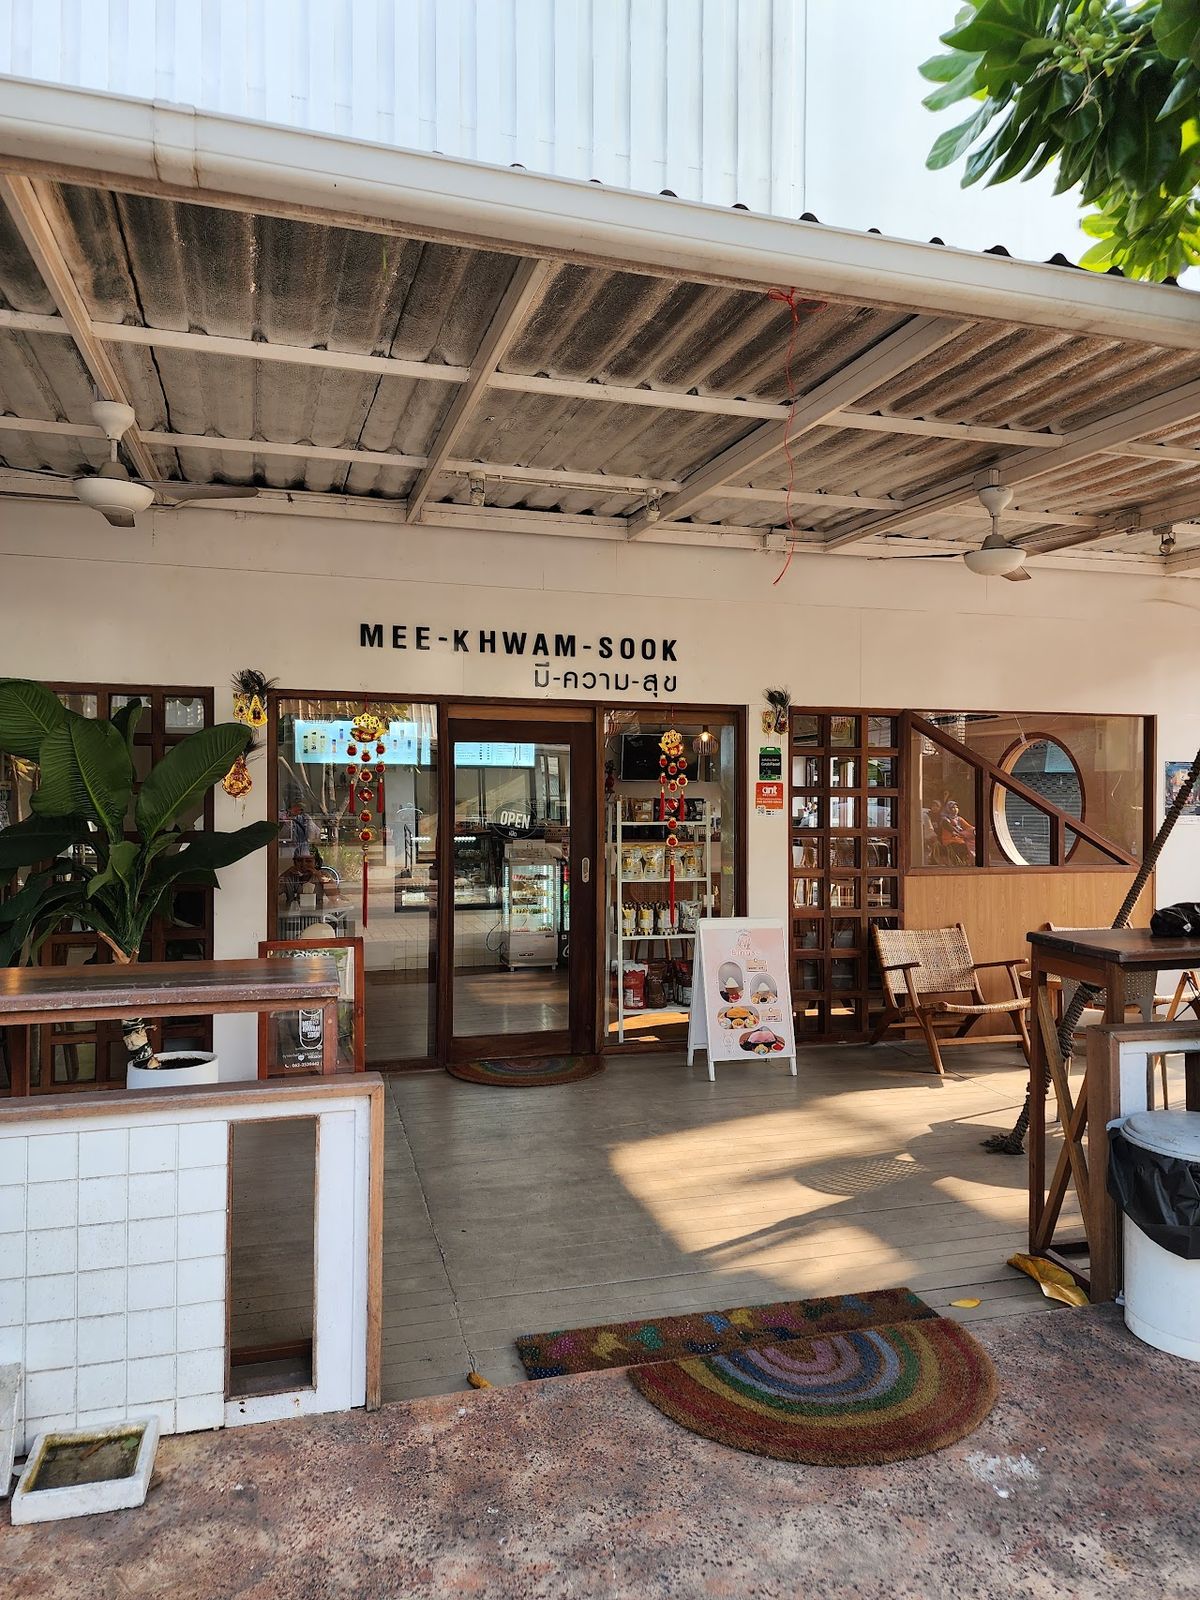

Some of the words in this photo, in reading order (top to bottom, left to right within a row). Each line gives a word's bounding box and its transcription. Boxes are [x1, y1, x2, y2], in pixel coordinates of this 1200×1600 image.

[359, 623, 678, 662] MEE-KHWAM-SOOK
[534, 662, 677, 697] มี-ความ-สุข
[500, 810, 531, 830] OPEN
